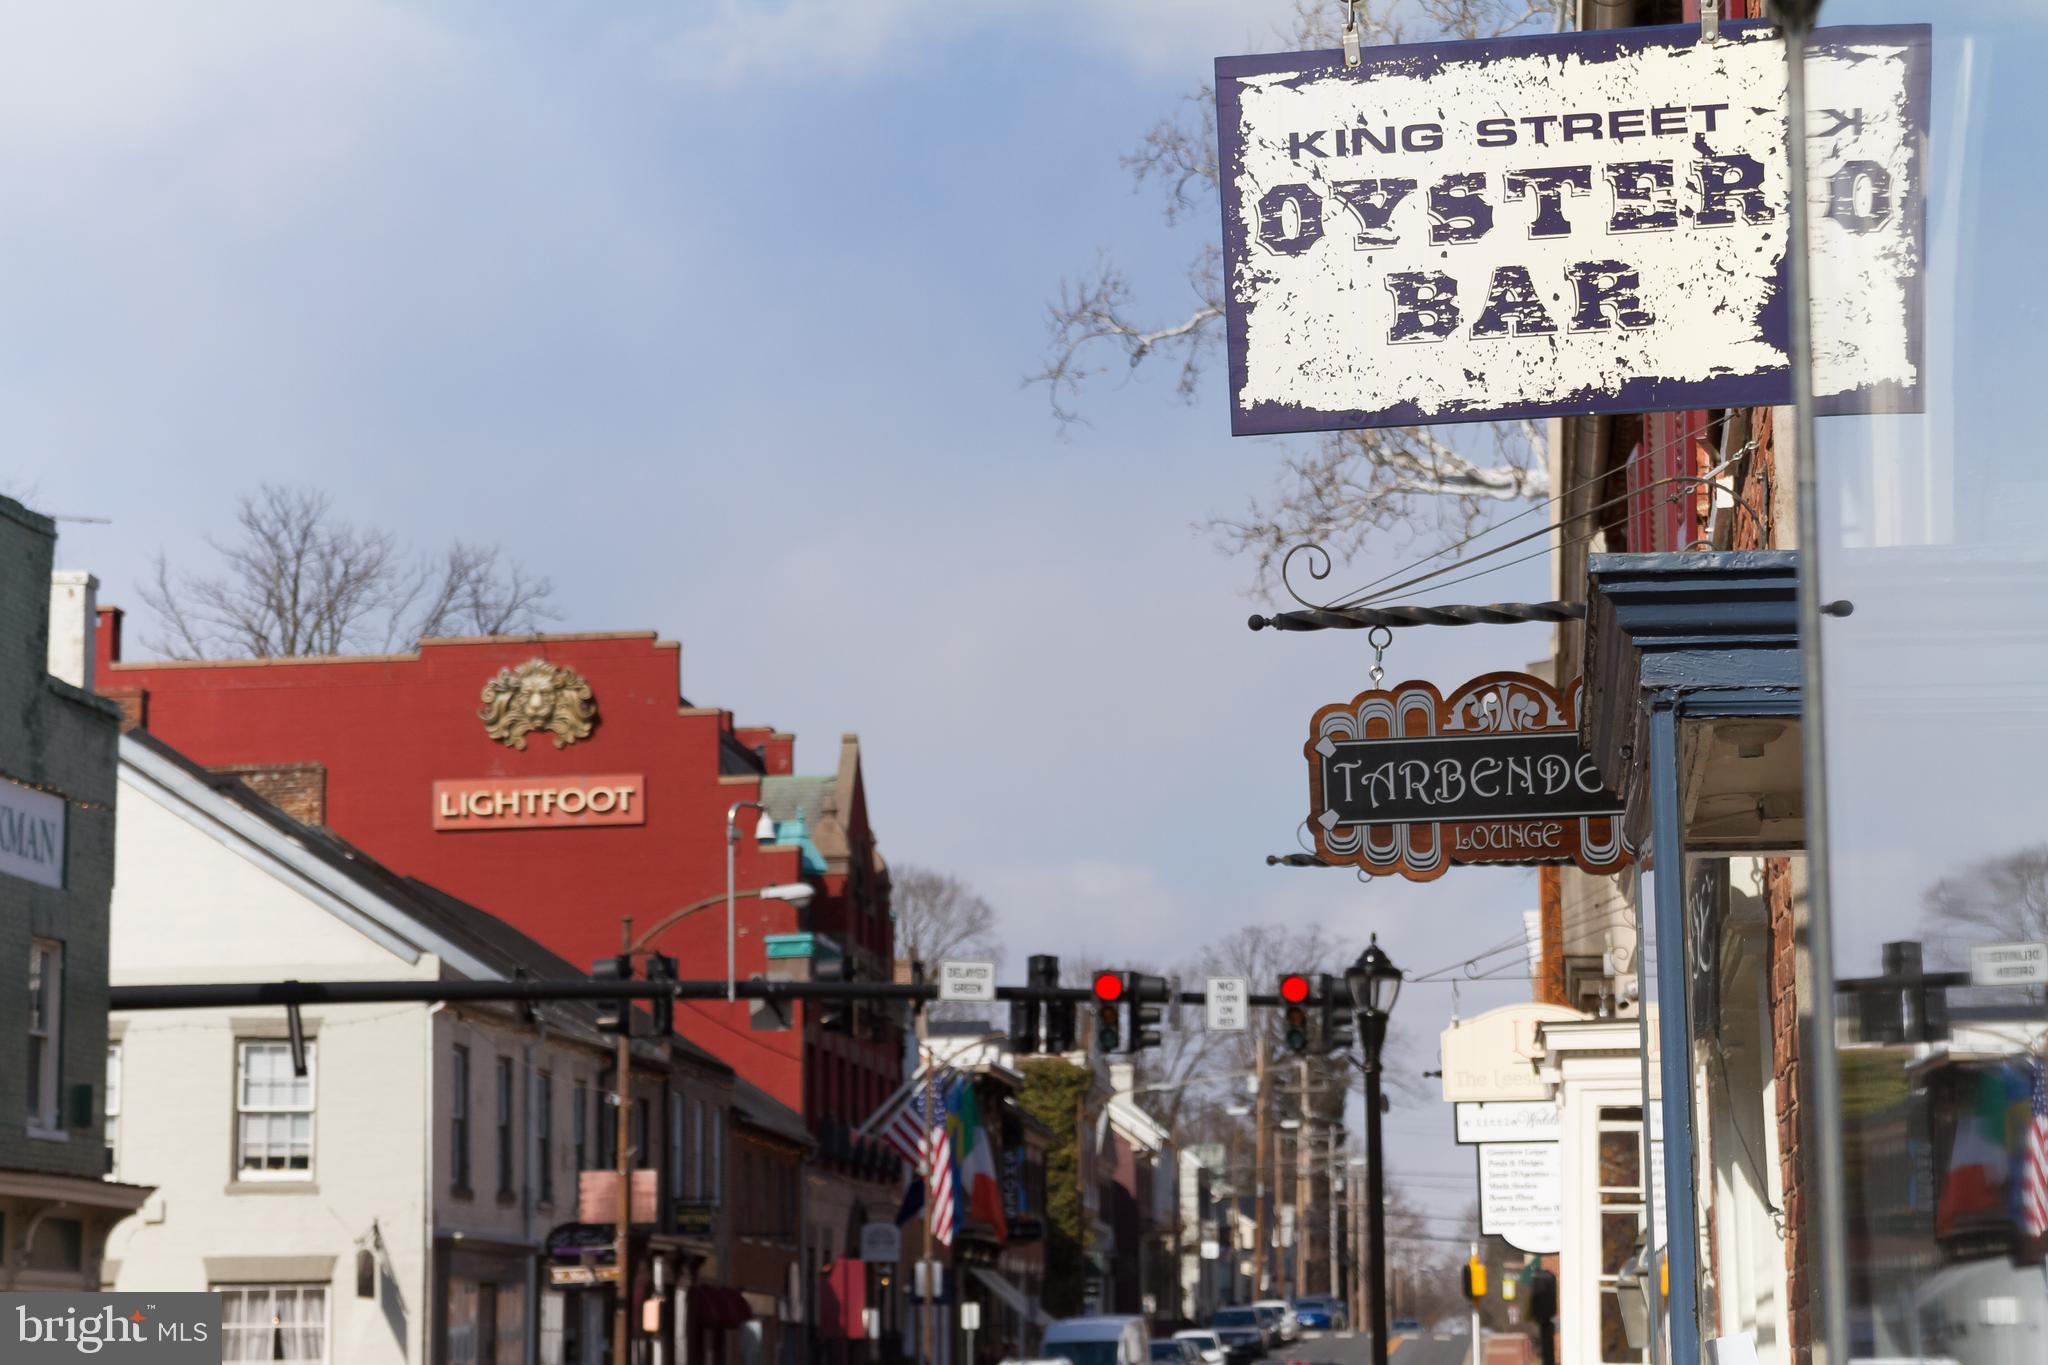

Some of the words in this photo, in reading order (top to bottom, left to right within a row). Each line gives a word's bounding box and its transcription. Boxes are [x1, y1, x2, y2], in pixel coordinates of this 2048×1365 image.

[1288, 122, 1444, 160] KING
[1476, 103, 1730, 148] STREET
[1254, 153, 1776, 257] OYSTER
[1384, 259, 1657, 346] BAR
[439, 785, 636, 818] LIGHTFOOT
[1454, 821, 1563, 851] LOUNGE
[1215, 994, 1240, 1003] TURN
[1216, 982, 1235, 992] NO
[1456, 1070, 1487, 1088] The
